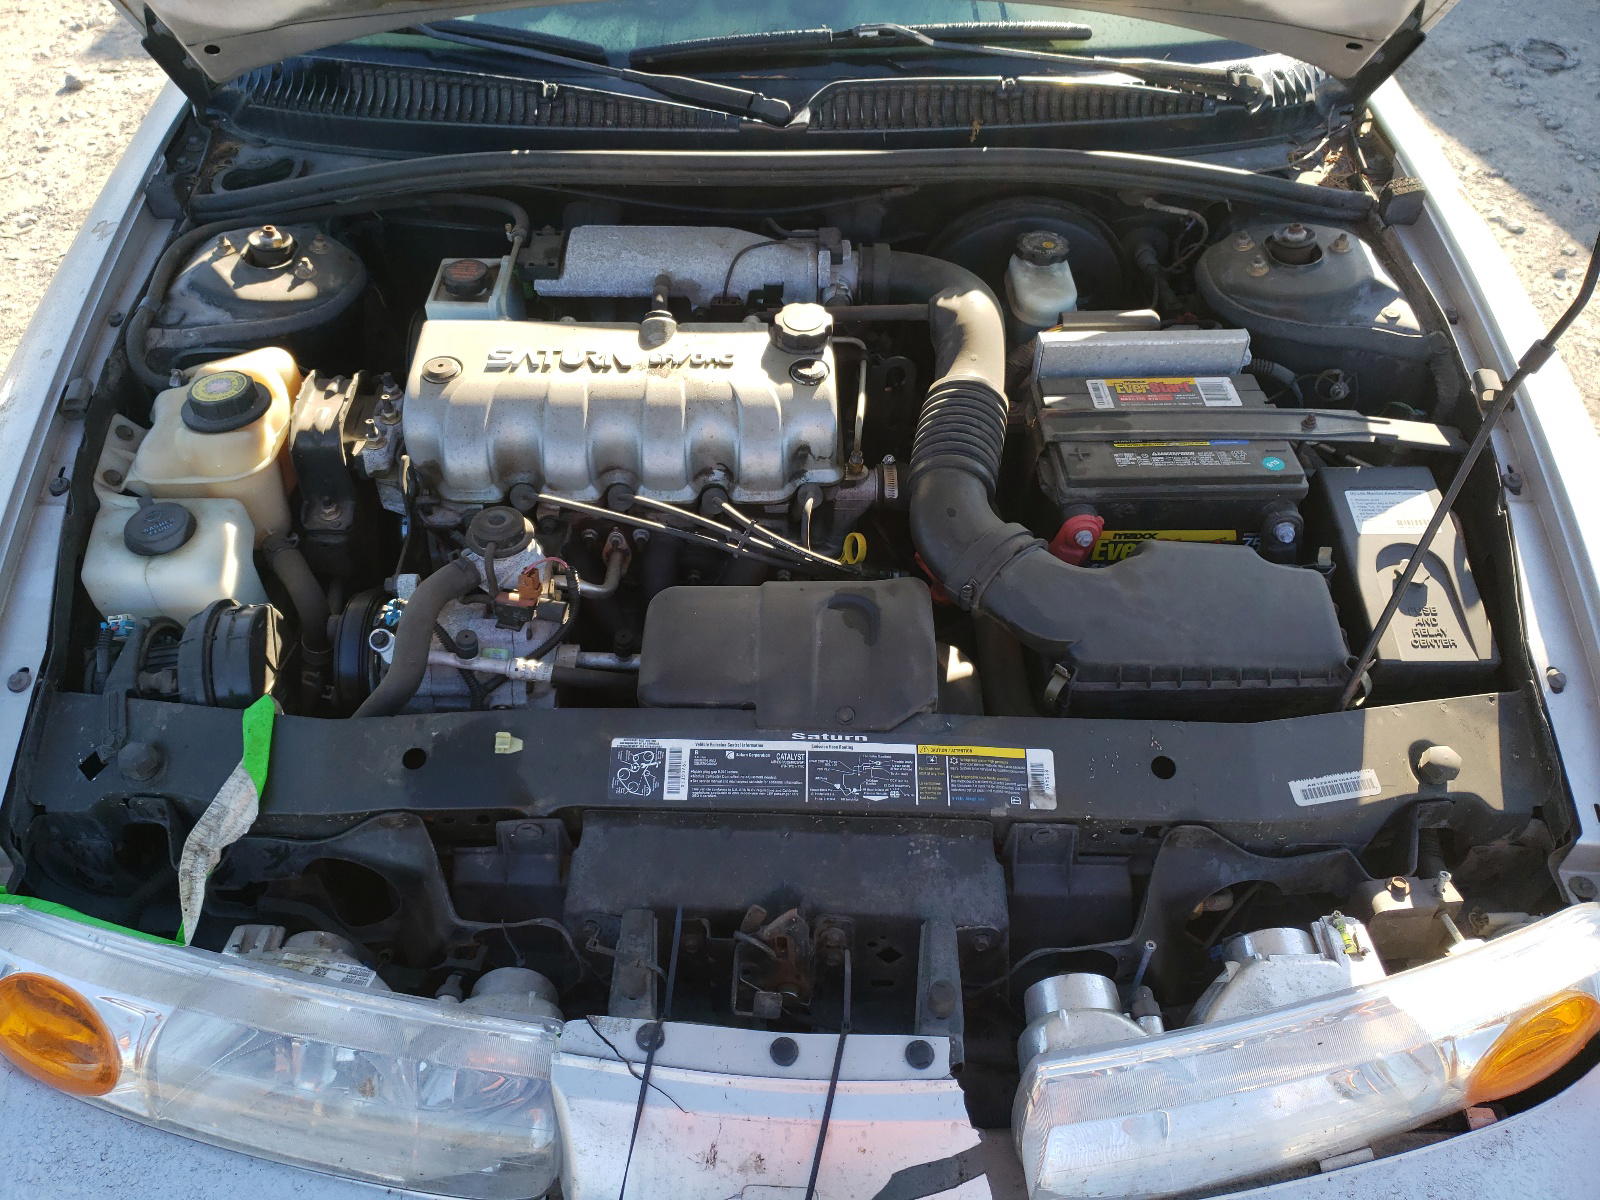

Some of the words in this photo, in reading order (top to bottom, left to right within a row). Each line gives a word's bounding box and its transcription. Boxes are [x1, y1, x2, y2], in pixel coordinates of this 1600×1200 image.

[484, 349, 632, 374] SATURN
[1415, 617, 1439, 628] AND
[1411, 628, 1448, 639] RELAY
[1410, 639, 1458, 649] CENTER
[791, 732, 868, 742] Saturn
[776, 752, 805, 760] CATALYST
